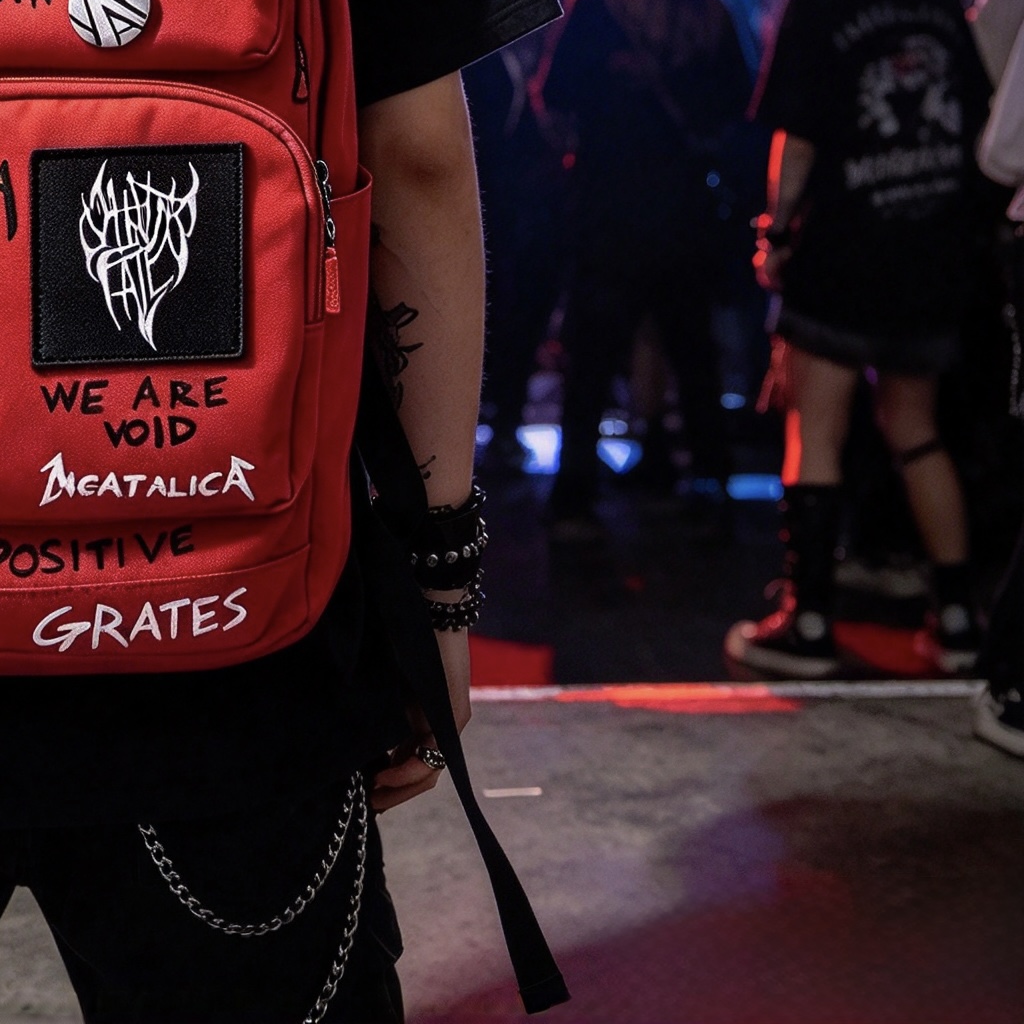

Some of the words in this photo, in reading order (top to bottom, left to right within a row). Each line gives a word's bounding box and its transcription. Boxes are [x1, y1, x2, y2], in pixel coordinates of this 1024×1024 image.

[40, 379, 109, 415] WE
[132, 375, 228, 411] ARE
[103, 415, 197, 449] VOID
[32, 587, 248, 652] GRATES
